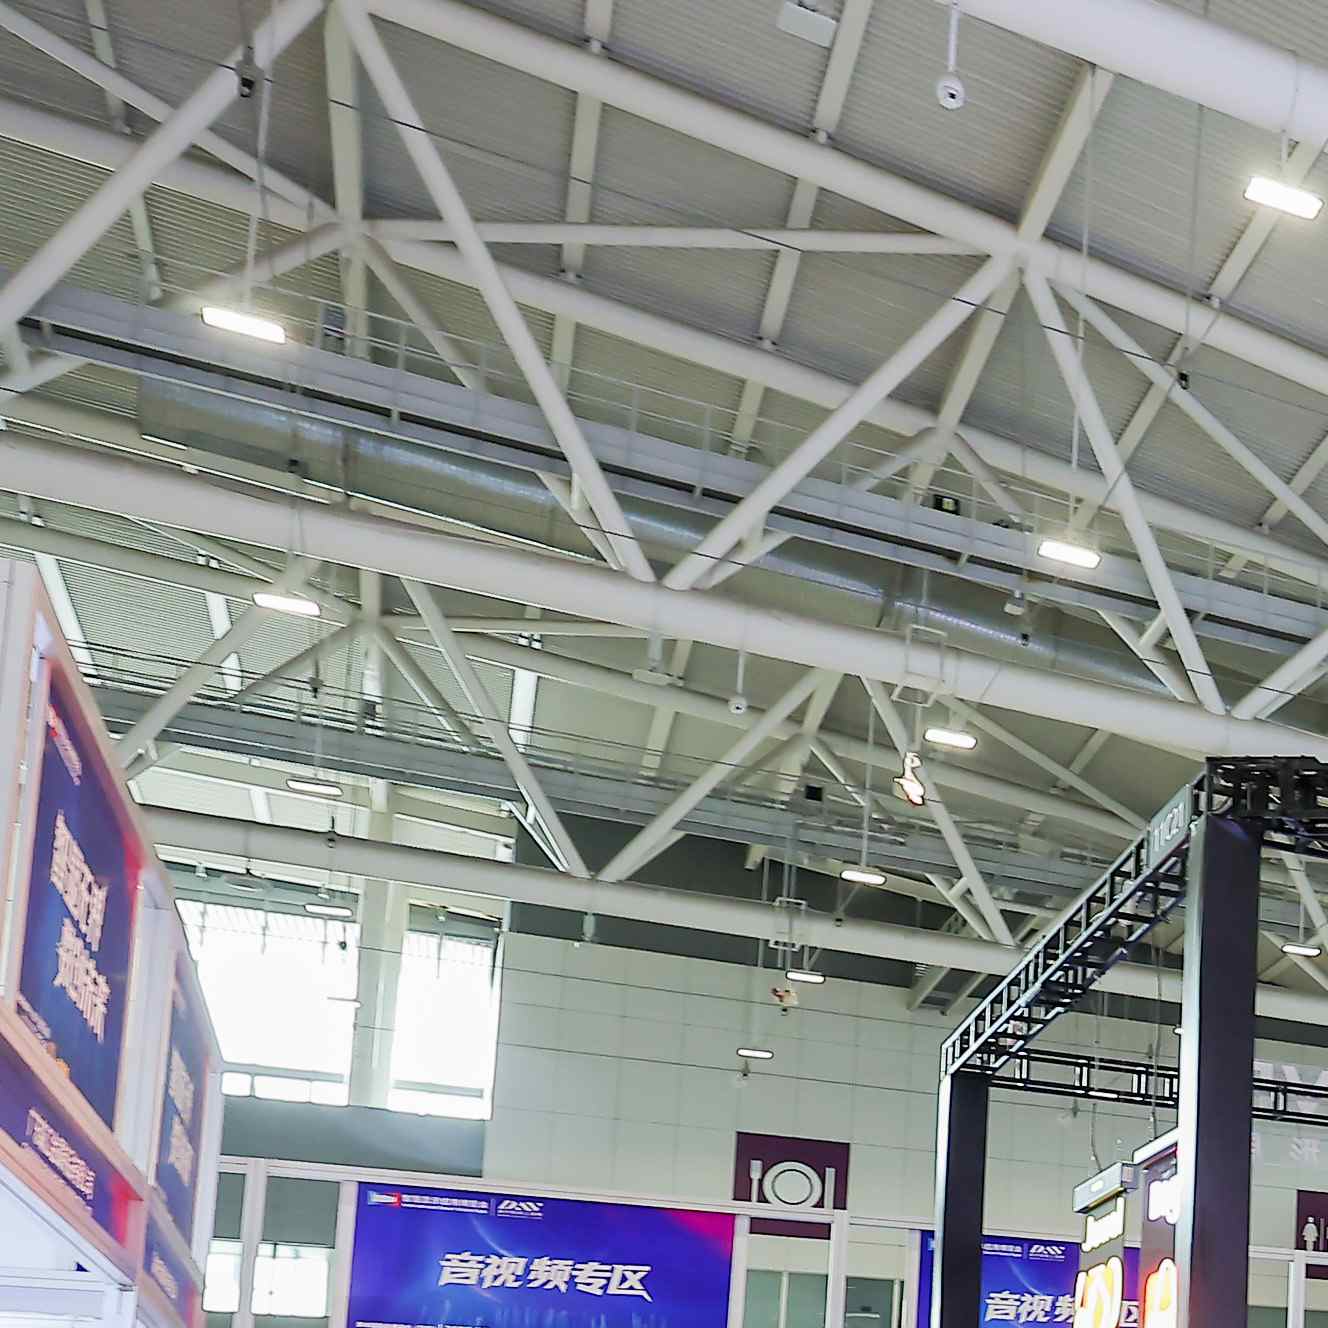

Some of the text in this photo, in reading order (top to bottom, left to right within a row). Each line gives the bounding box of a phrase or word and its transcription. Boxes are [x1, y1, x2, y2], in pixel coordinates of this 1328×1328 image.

[438, 1251, 653, 1302] 音视频专区
[984, 1290, 1139, 1327] 音视区
